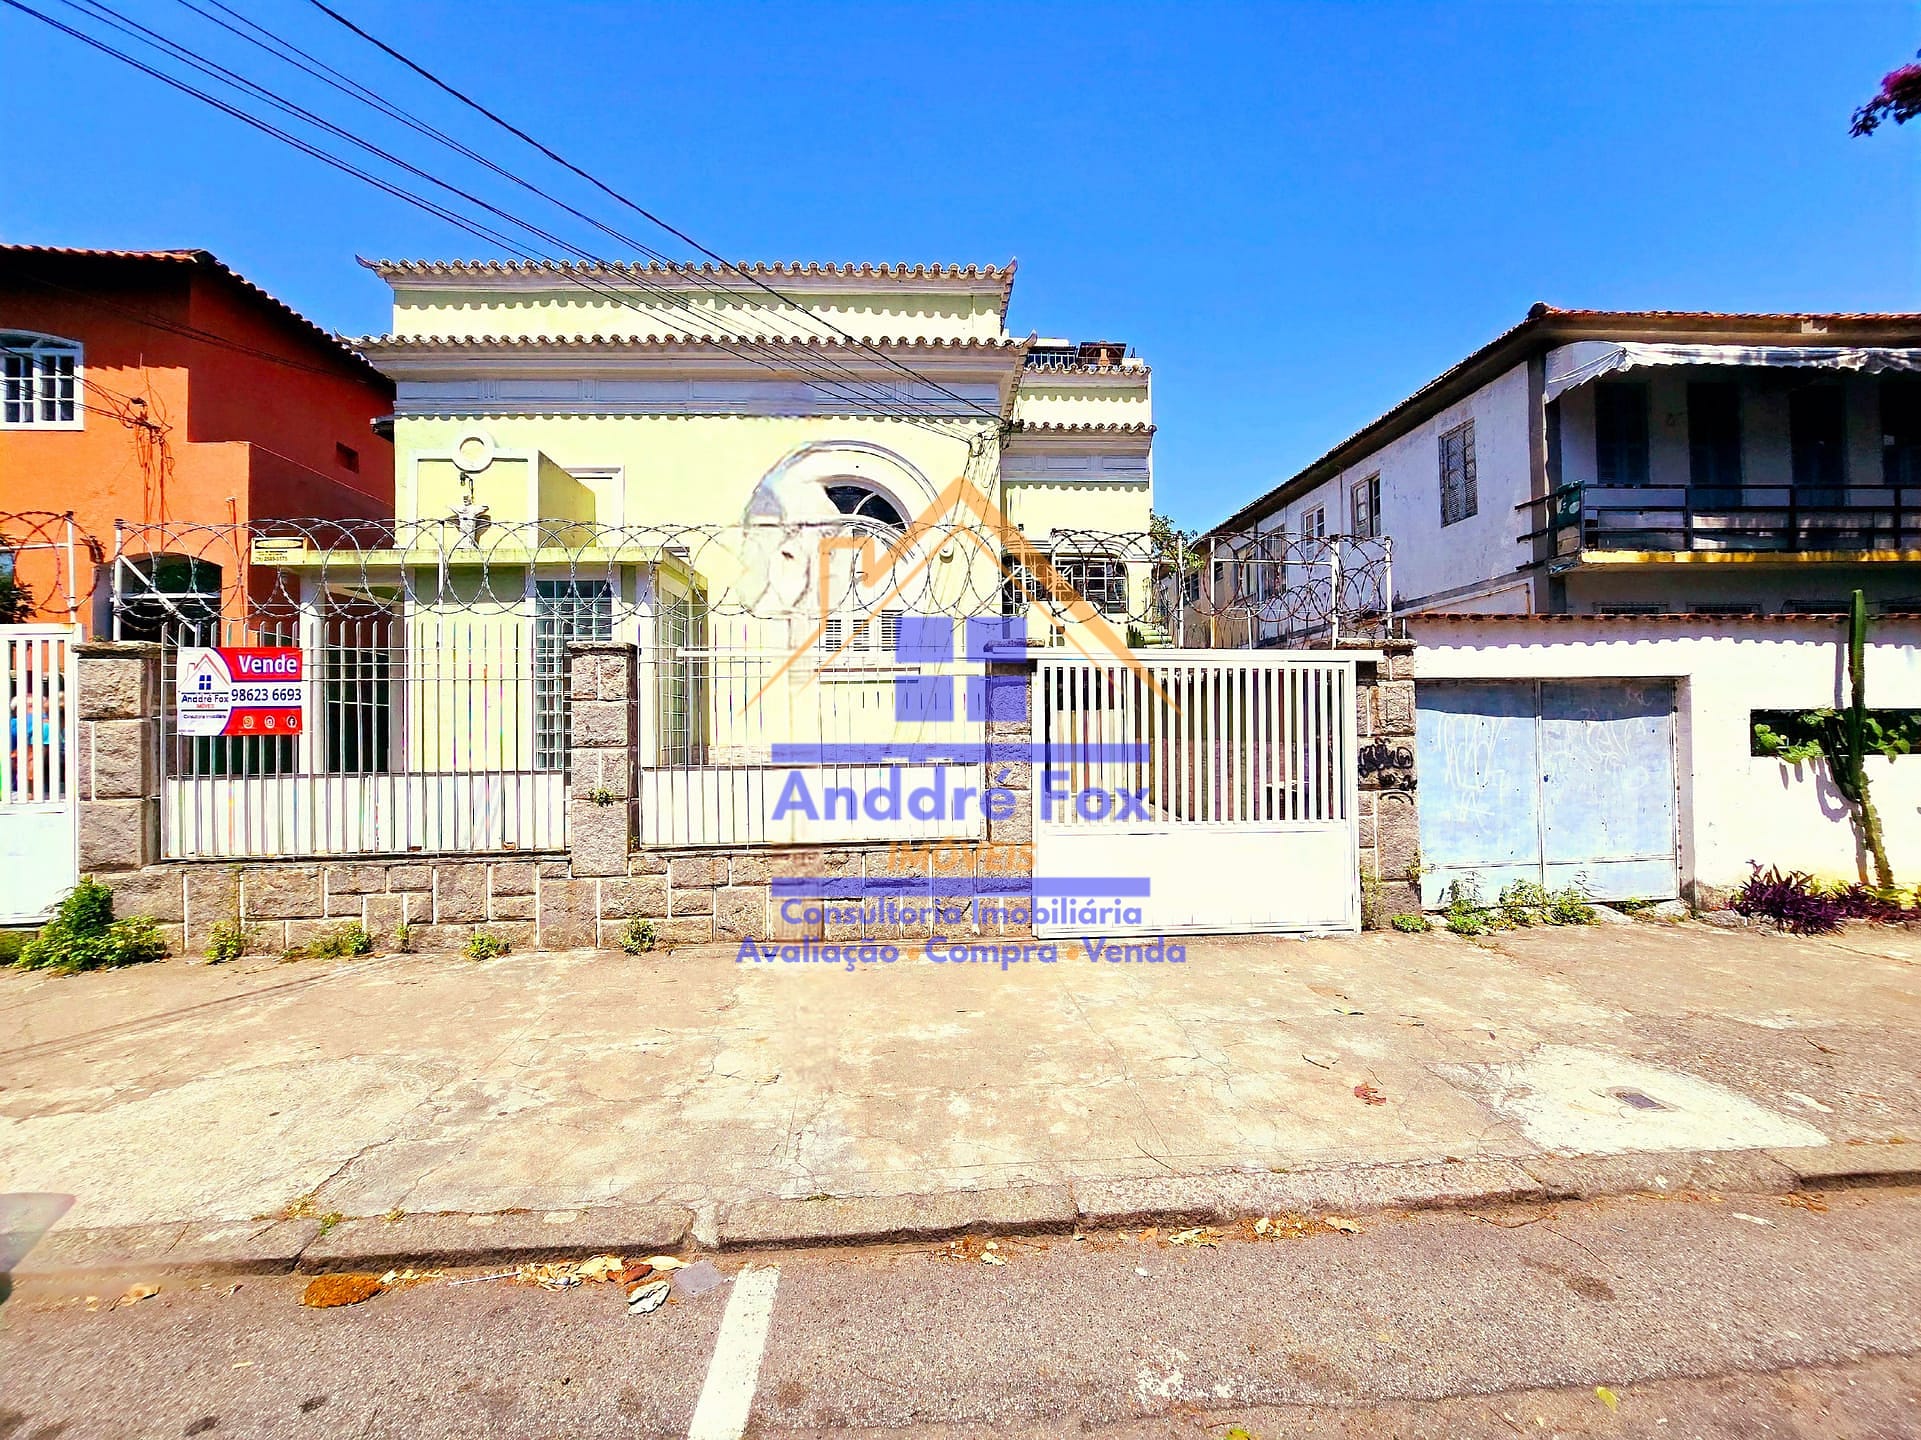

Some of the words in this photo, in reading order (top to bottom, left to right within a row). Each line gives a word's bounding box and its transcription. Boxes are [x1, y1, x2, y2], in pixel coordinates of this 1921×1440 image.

[238, 653, 297, 673] Vende
[181, 694, 212, 703] Anddré
[214, 694, 229, 703] Fox
[231, 688, 269, 702] 98623
[272, 688, 302, 702] 6693
